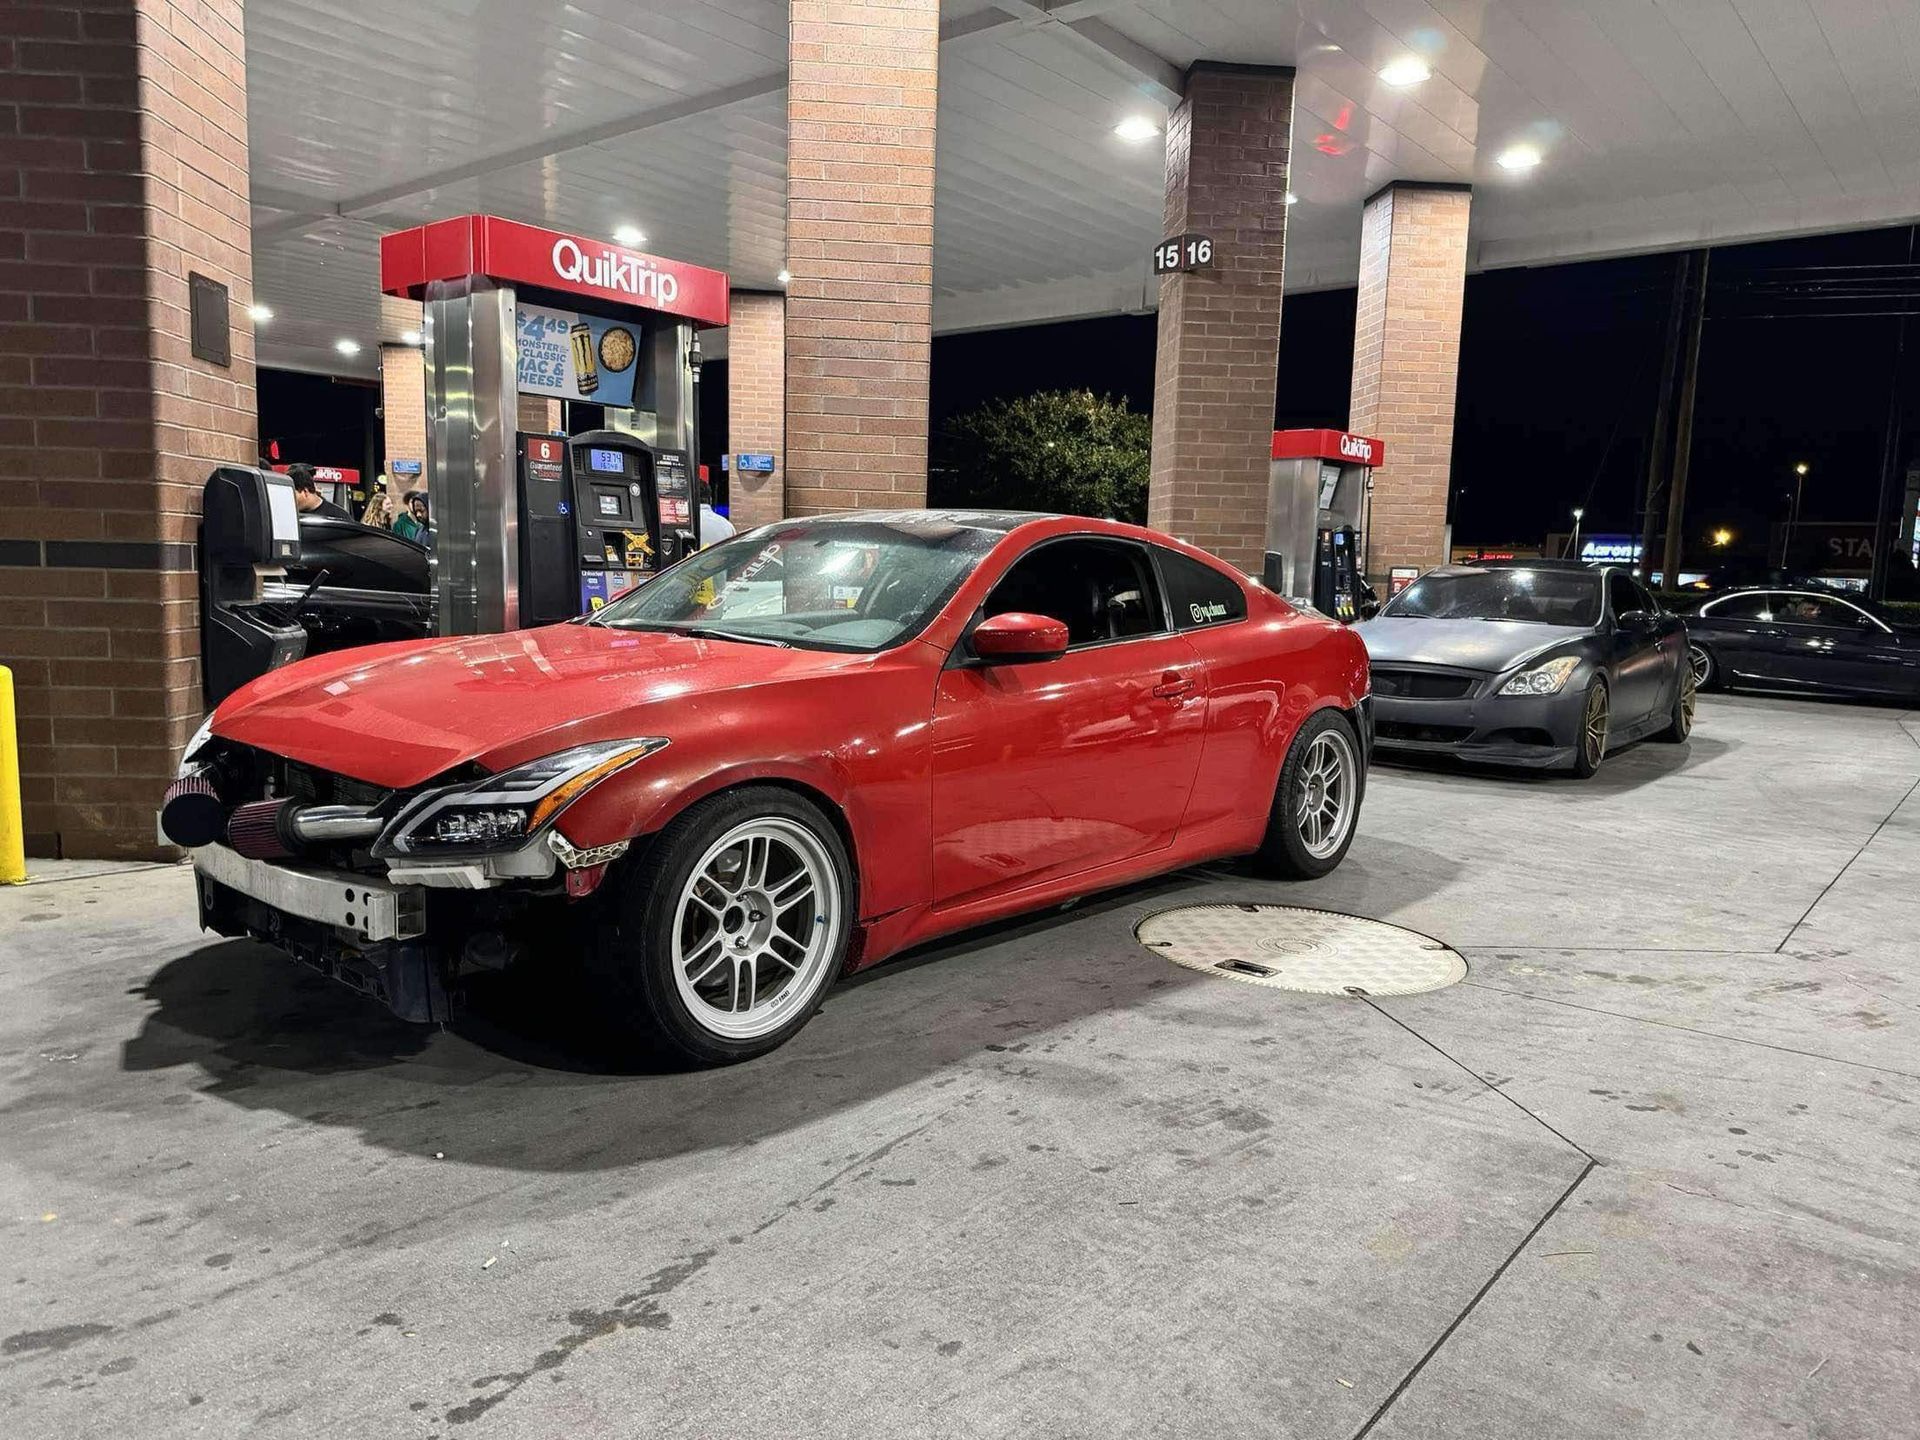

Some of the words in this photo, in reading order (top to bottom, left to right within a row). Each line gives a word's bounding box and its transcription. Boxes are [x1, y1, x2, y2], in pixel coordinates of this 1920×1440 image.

[1155, 244, 1179, 269] 15
[1187, 240, 1211, 265] 16
[552, 238, 678, 308] QuikTrip
[522, 348, 567, 363] CLASSIC
[552, 362, 564, 377] &
[518, 371, 564, 388] HEESE
[540, 442, 551, 459] 6
[1340, 434, 1372, 463] QuikTrip
[314, 467, 343, 482] ikTrip
